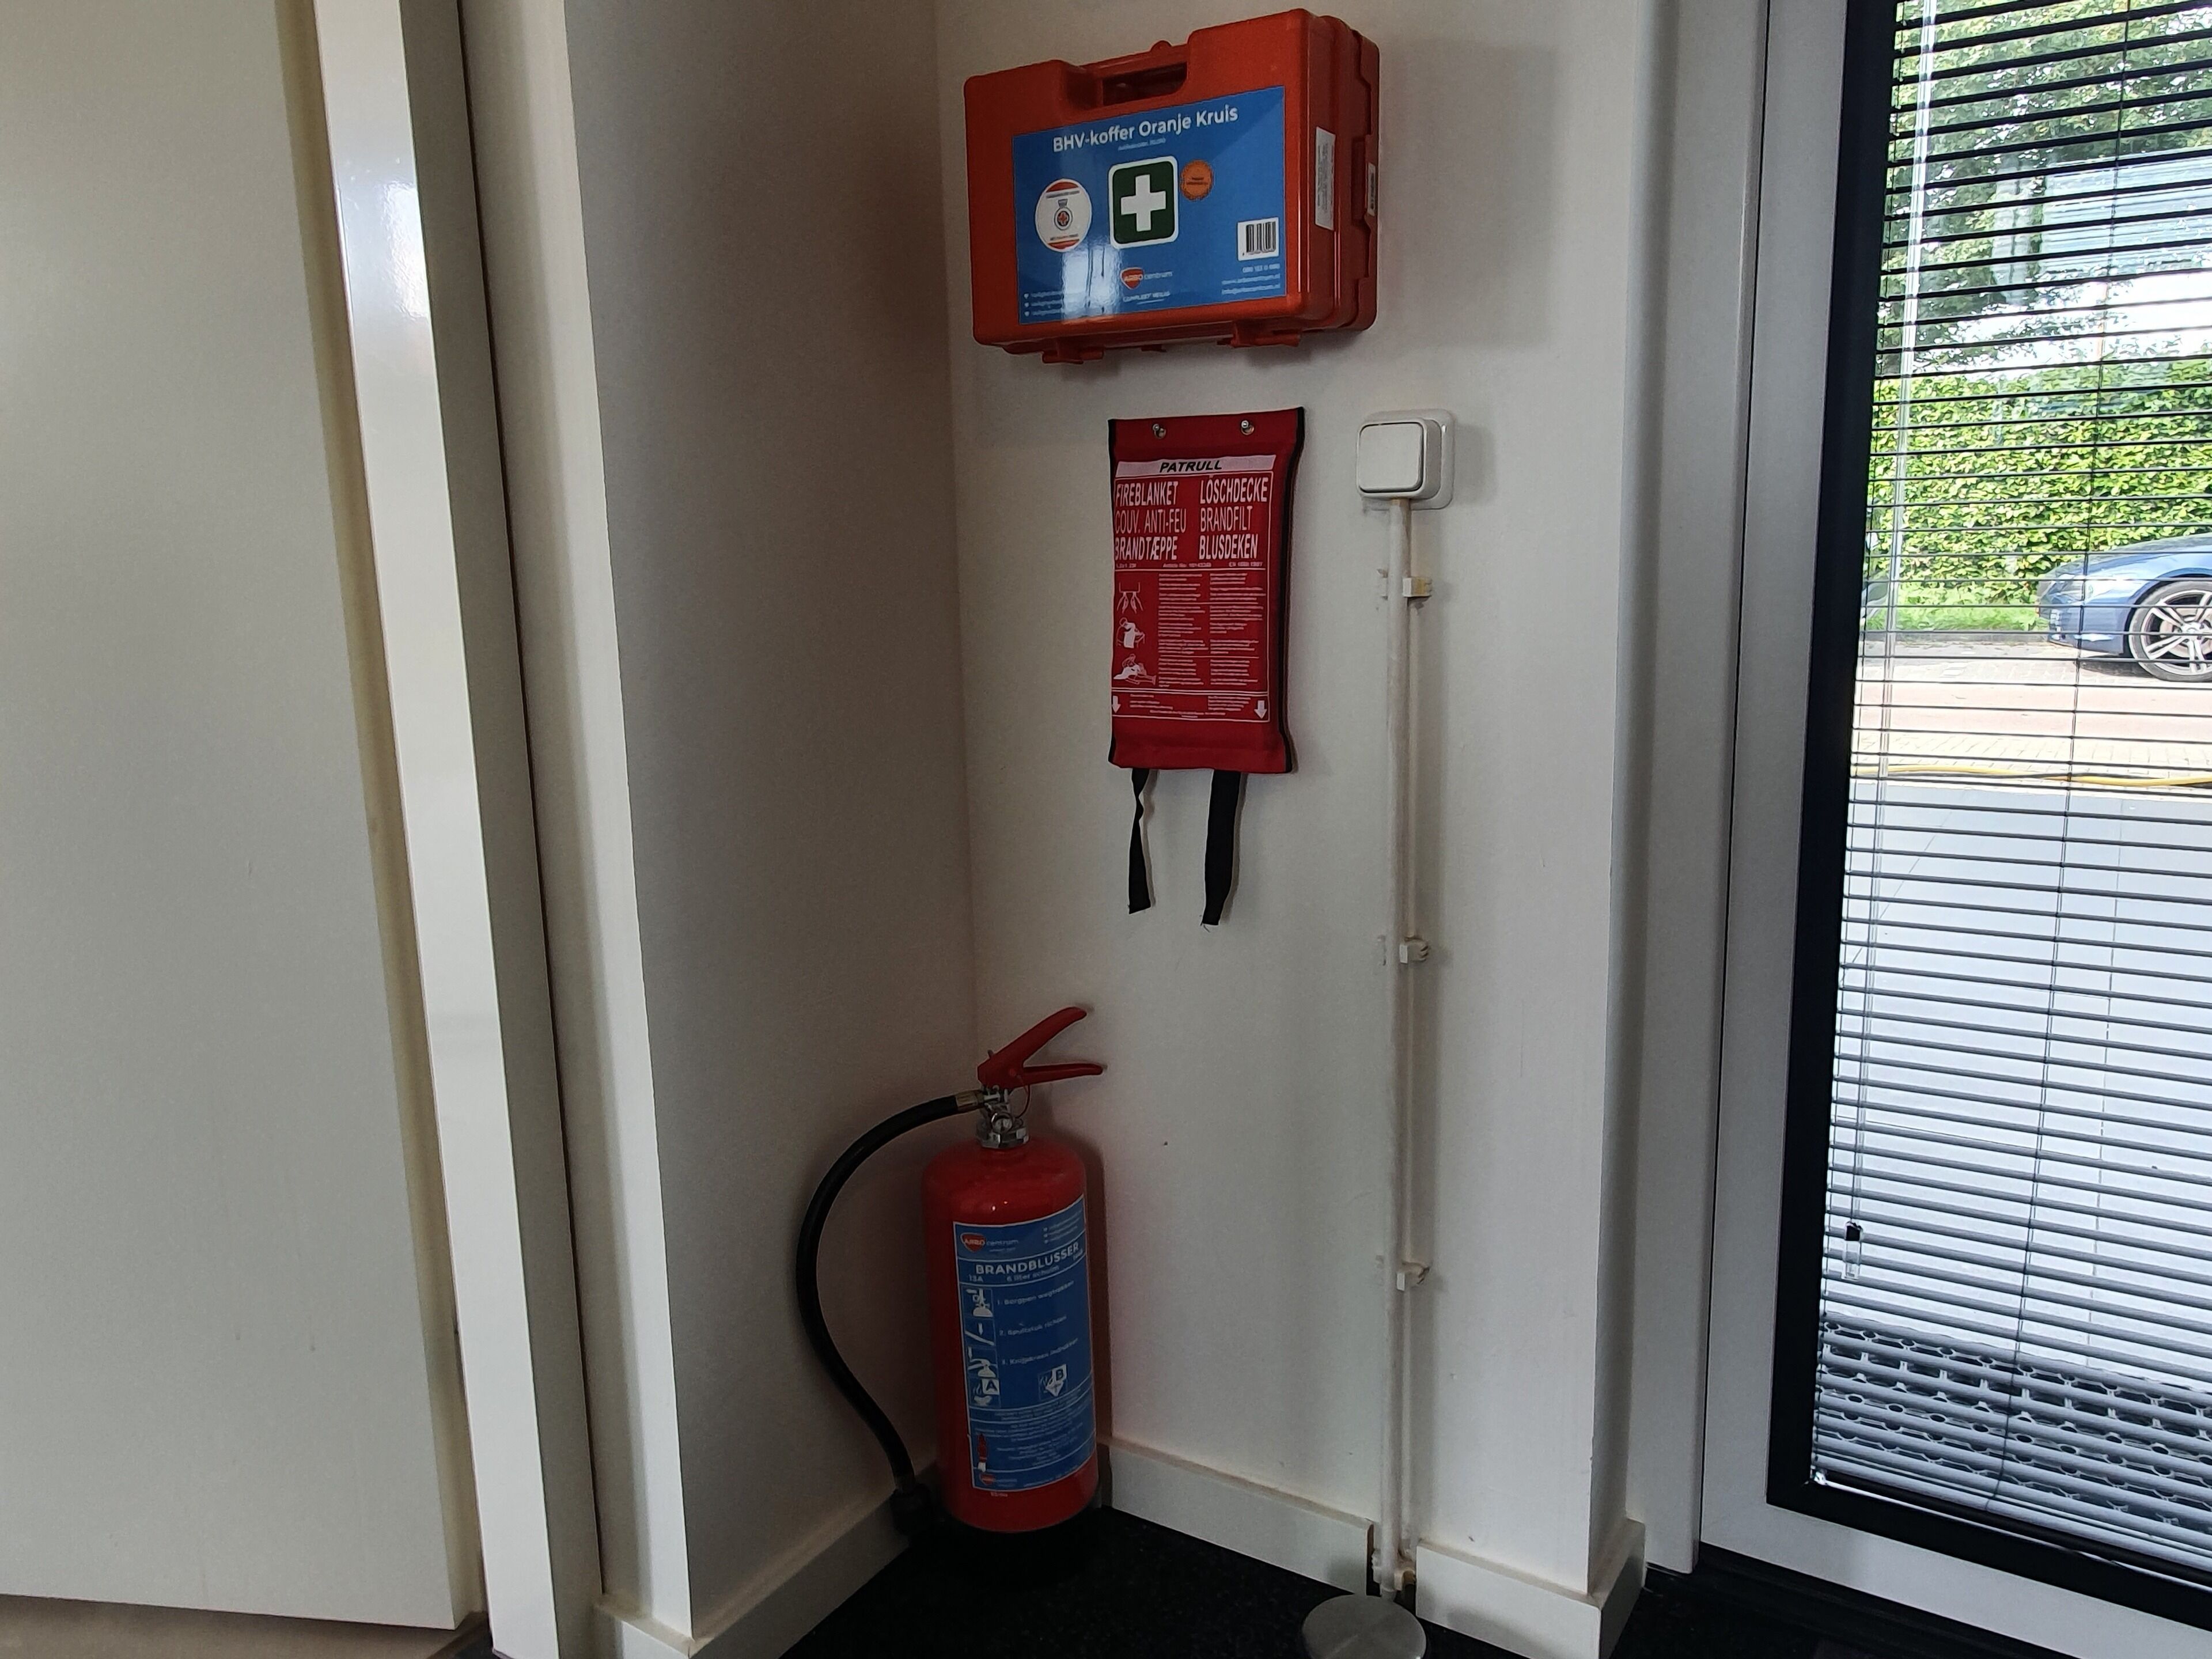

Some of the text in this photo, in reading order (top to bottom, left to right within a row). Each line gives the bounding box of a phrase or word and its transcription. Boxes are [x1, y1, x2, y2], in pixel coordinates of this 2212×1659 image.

[1053, 124, 1135, 152] BHV-koffer
[1138, 113, 1192, 136] Oranje
[1196, 104, 1238, 127] Kruis
[1159, 460, 1223, 473] PATRULL
[1116, 480, 1179, 507] FIREBLANKET
[1115, 508, 1187, 534] COUV. ANTI-FEU
[1200, 505, 1253, 533] BRANDFILT
[1114, 536, 1179, 561] BRANDTÆPPE
[1199, 533, 1259, 560] BLUSDEKEN
[976, 1241, 1080, 1275] BRANDBLUSSER
